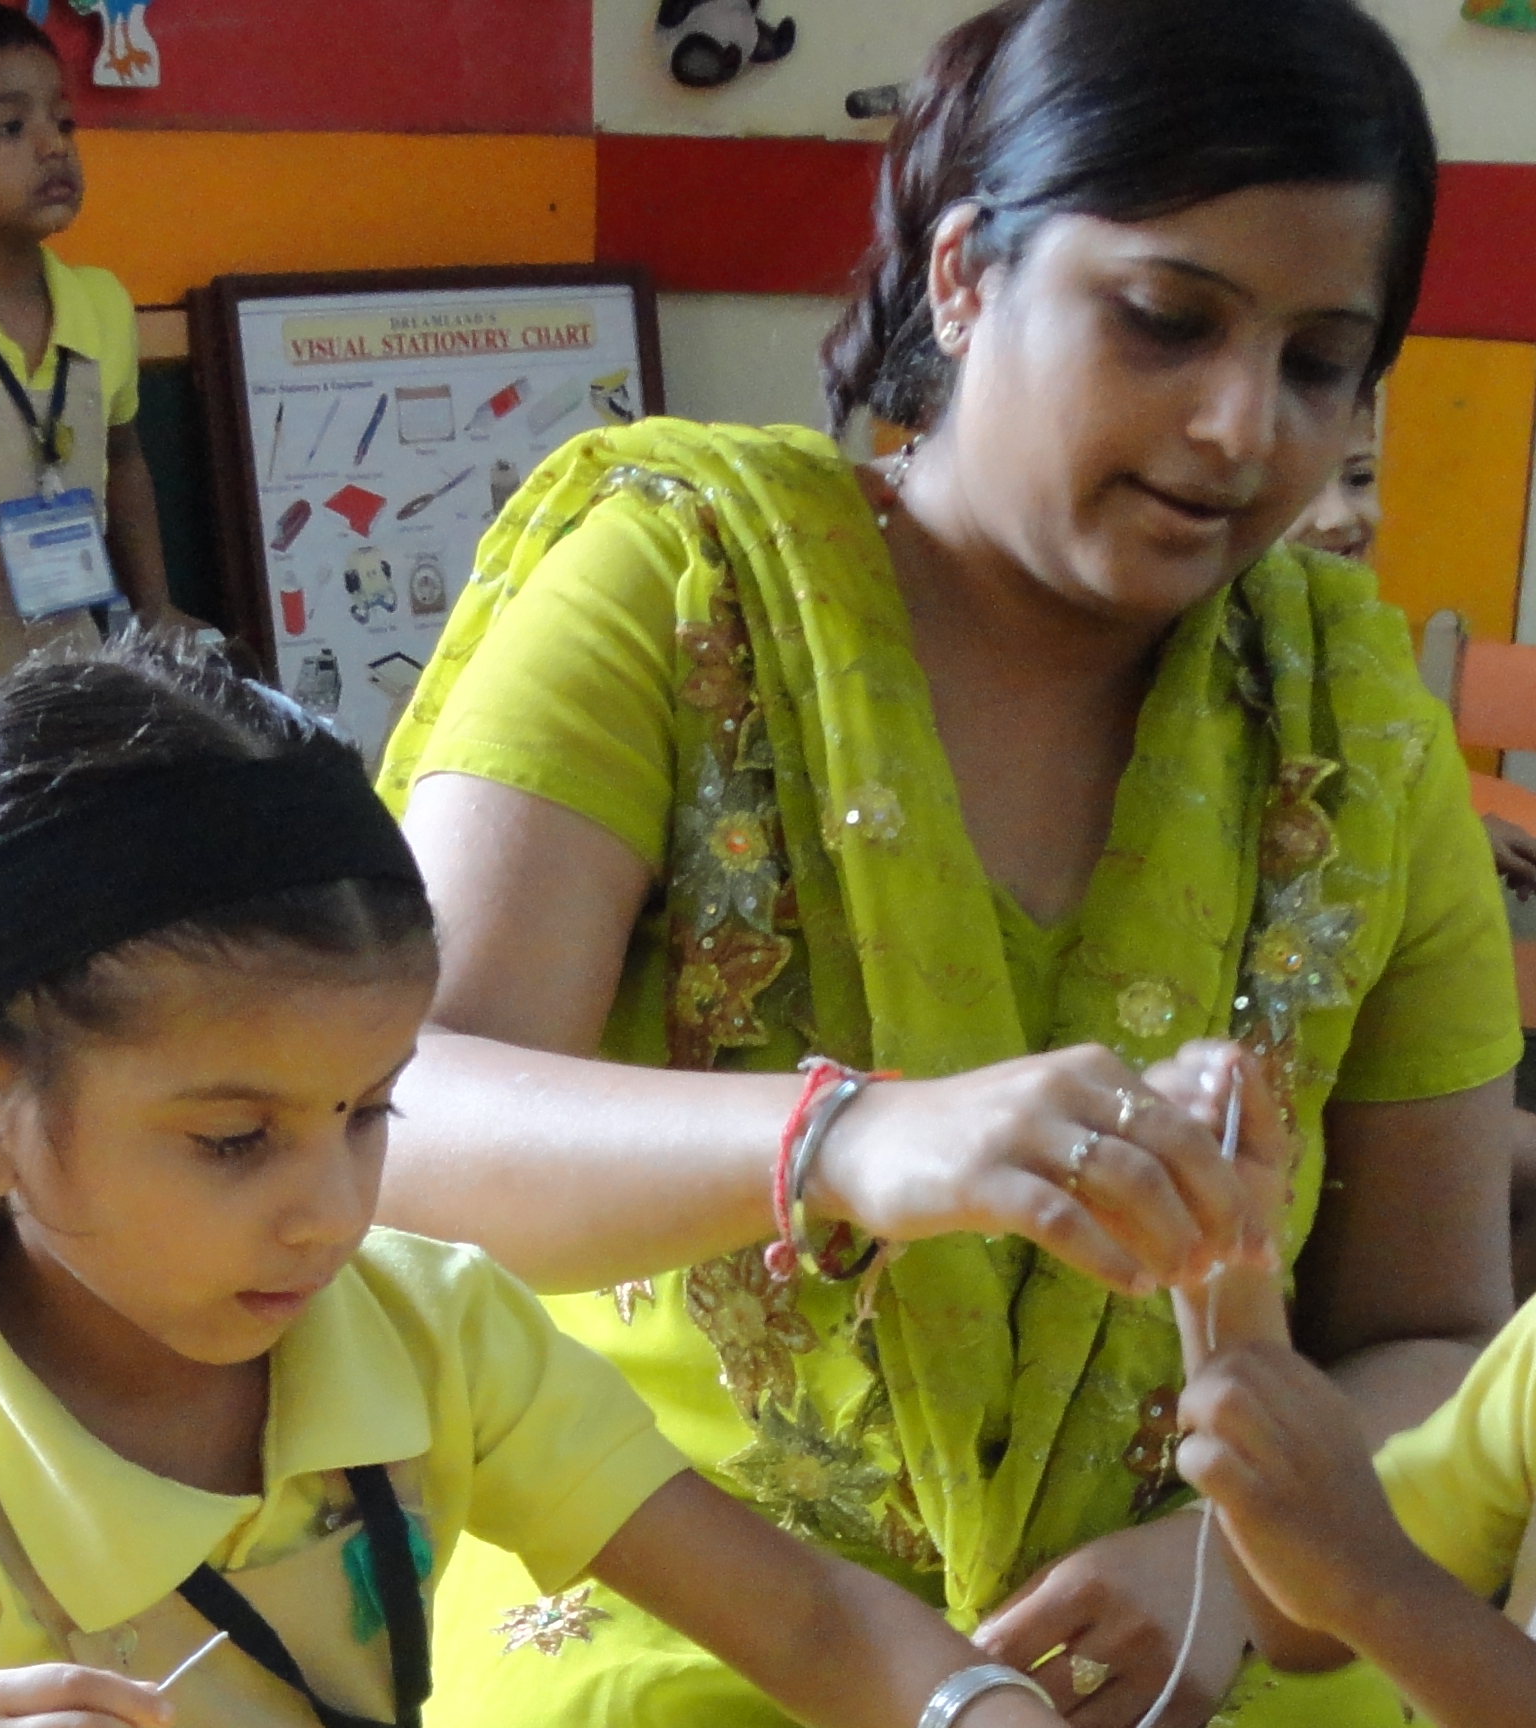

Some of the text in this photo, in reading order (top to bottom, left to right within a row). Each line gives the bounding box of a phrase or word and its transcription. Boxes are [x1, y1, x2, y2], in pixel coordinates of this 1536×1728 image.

[290, 323, 591, 359] VISUAL STATIONERY CHART
